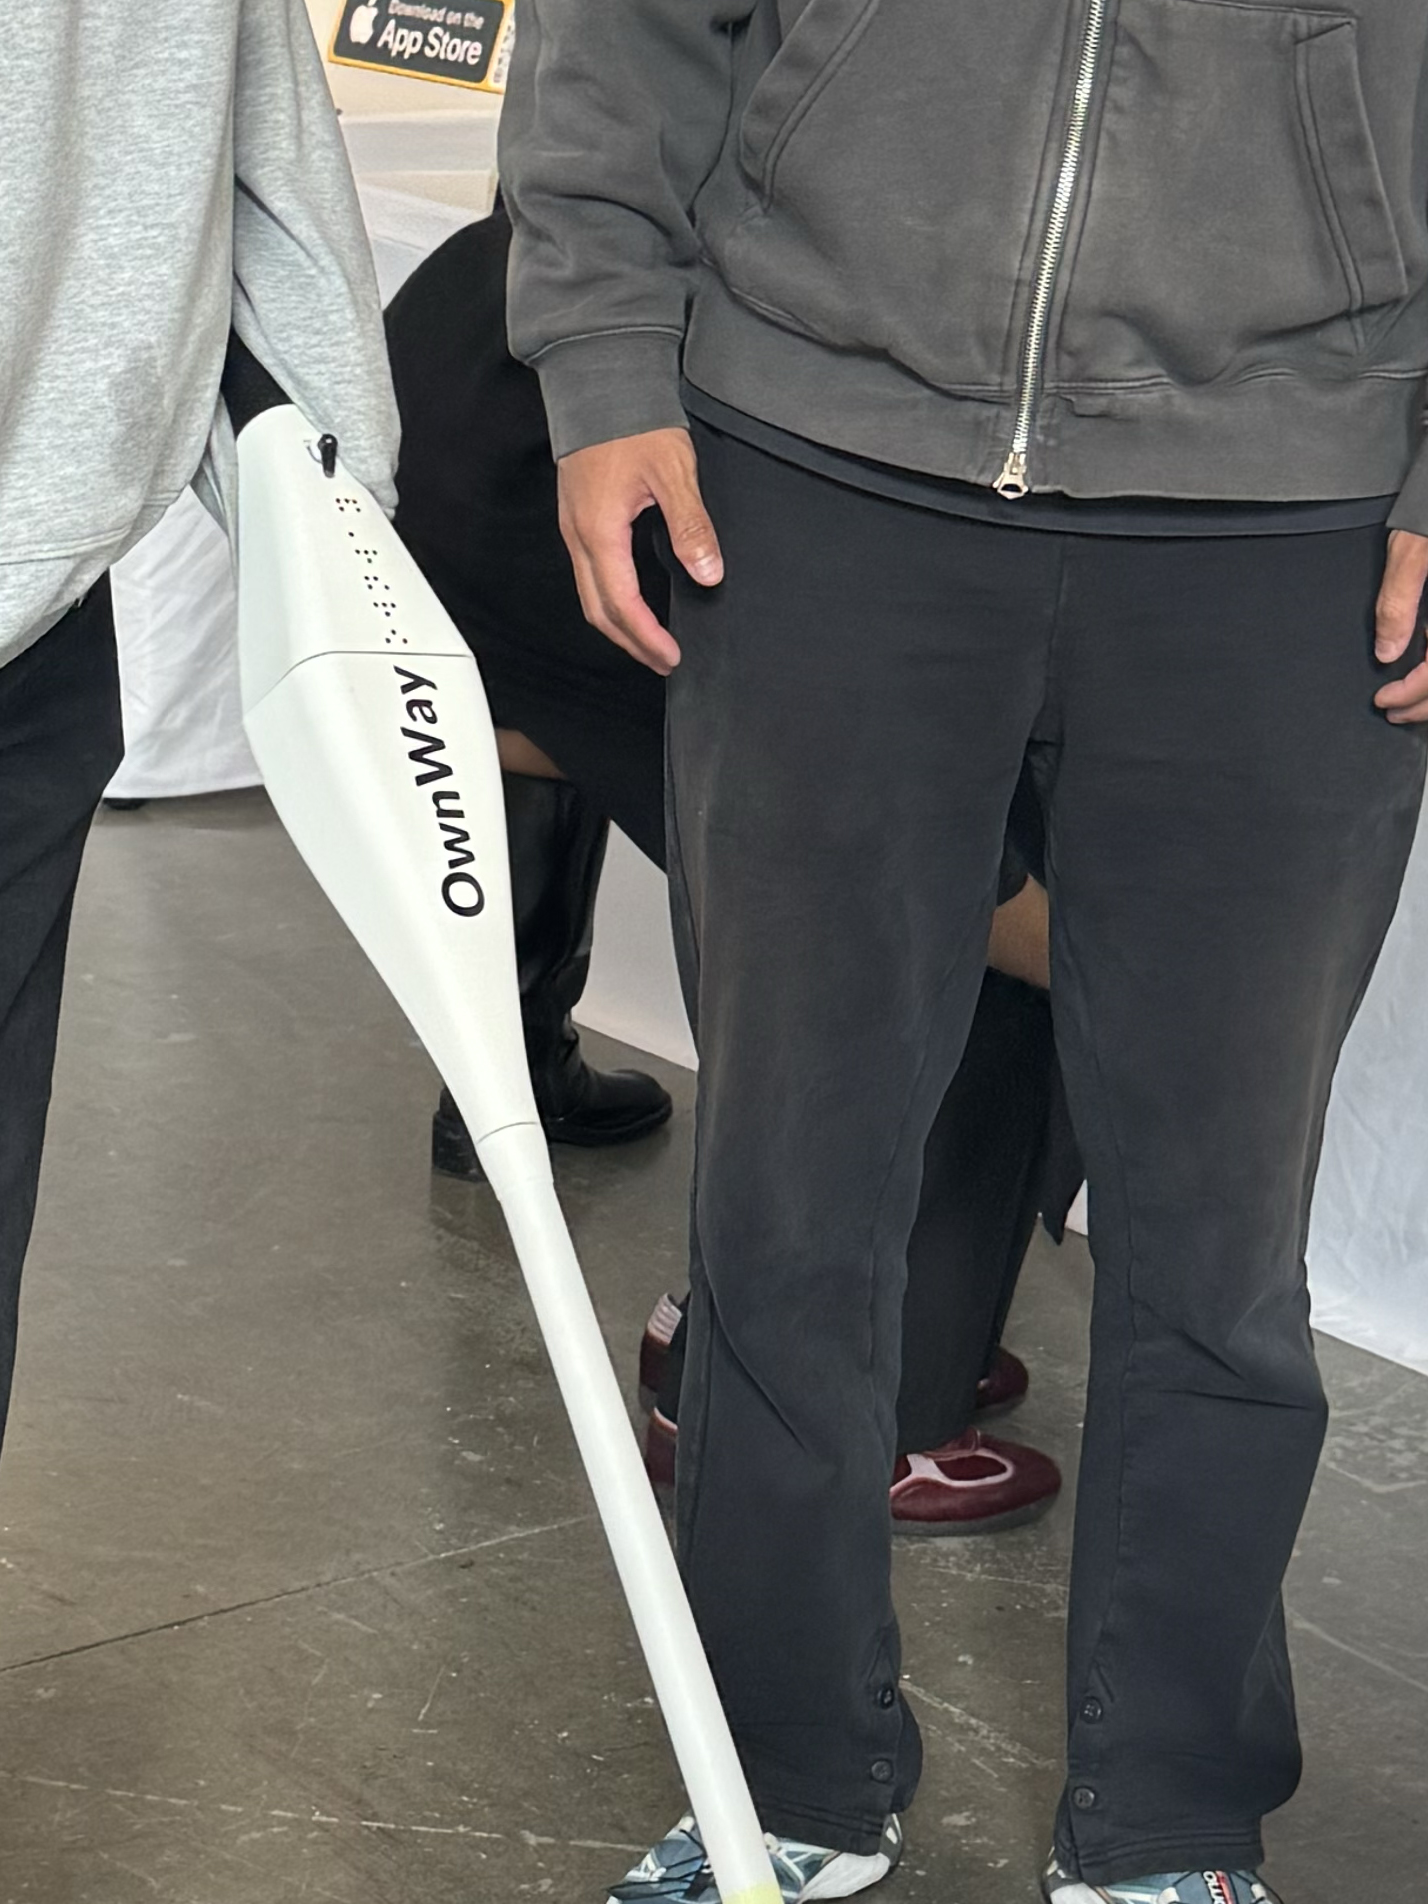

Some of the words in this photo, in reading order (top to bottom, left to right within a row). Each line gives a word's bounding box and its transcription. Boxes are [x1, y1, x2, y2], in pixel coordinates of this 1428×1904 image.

[377, 18, 423, 60] App
[424, 26, 483, 66] Store
[446, 10, 462, 26] on
[463, 11, 485, 30] the
[392, 664, 486, 918] OwnWay
